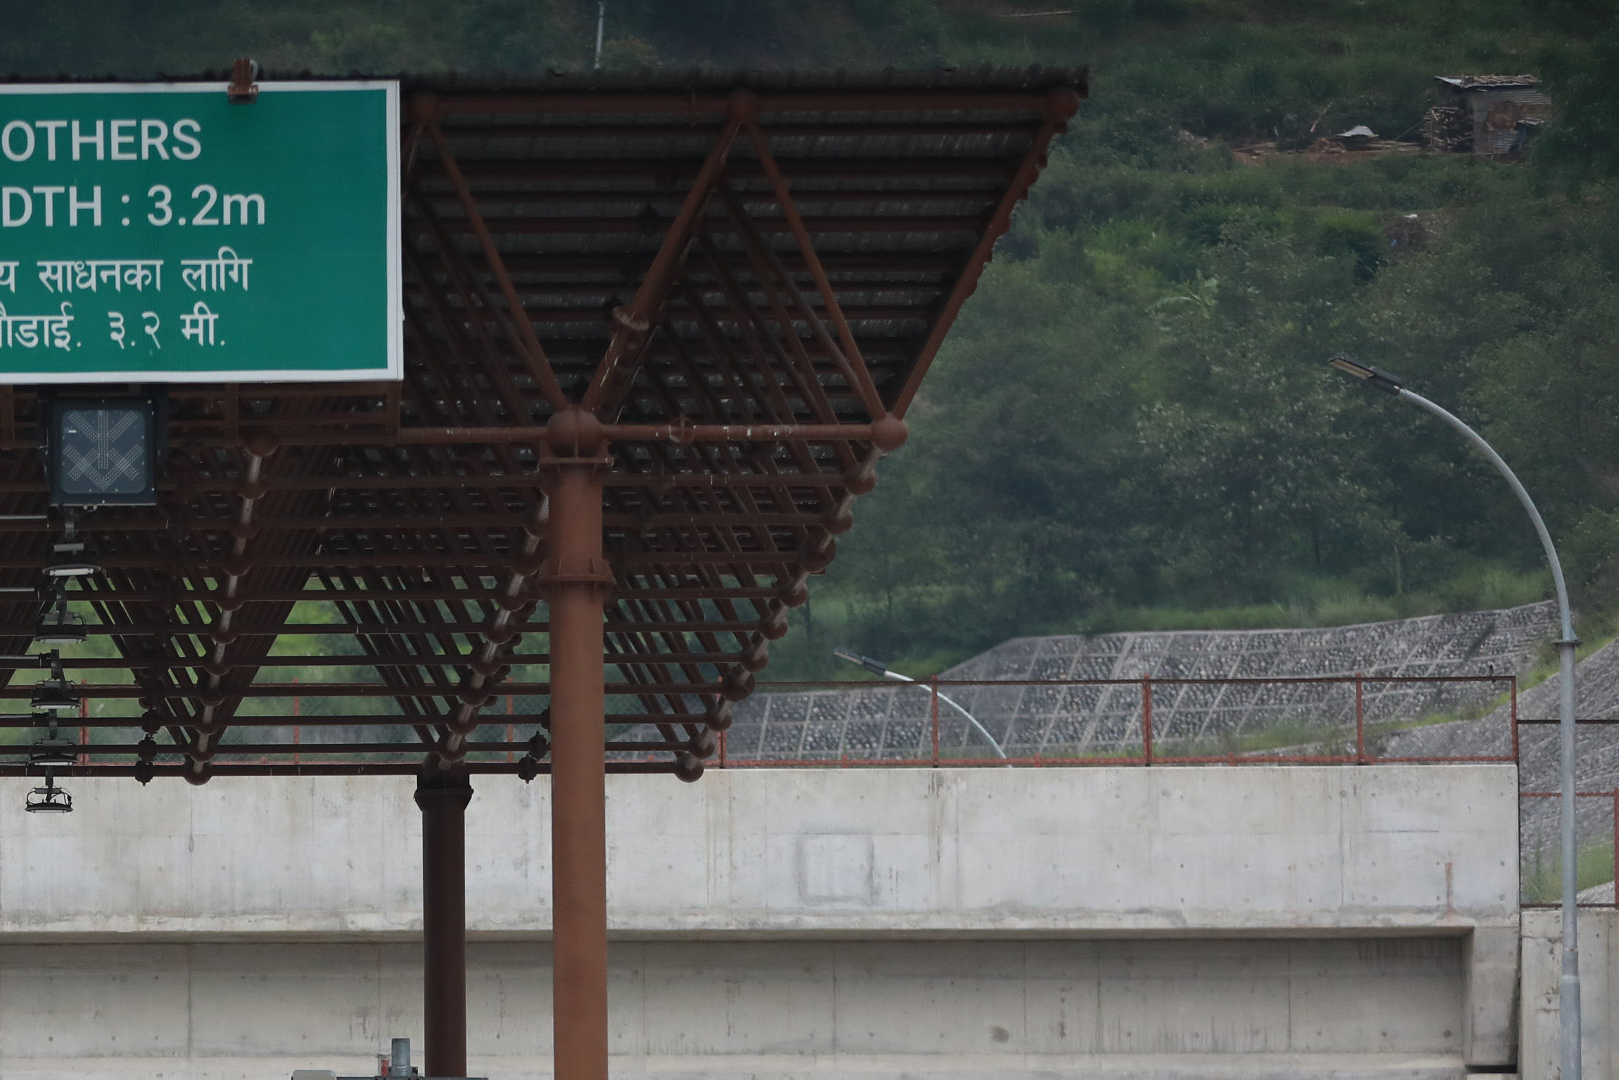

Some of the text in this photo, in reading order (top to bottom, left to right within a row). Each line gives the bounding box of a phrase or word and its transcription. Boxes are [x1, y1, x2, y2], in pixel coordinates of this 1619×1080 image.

[1, 118, 202, 162] OTHERS
[147, 184, 266, 227] 3.2m
[36, 259, 165, 293] साधनका
[180, 245, 254, 292] लागि
